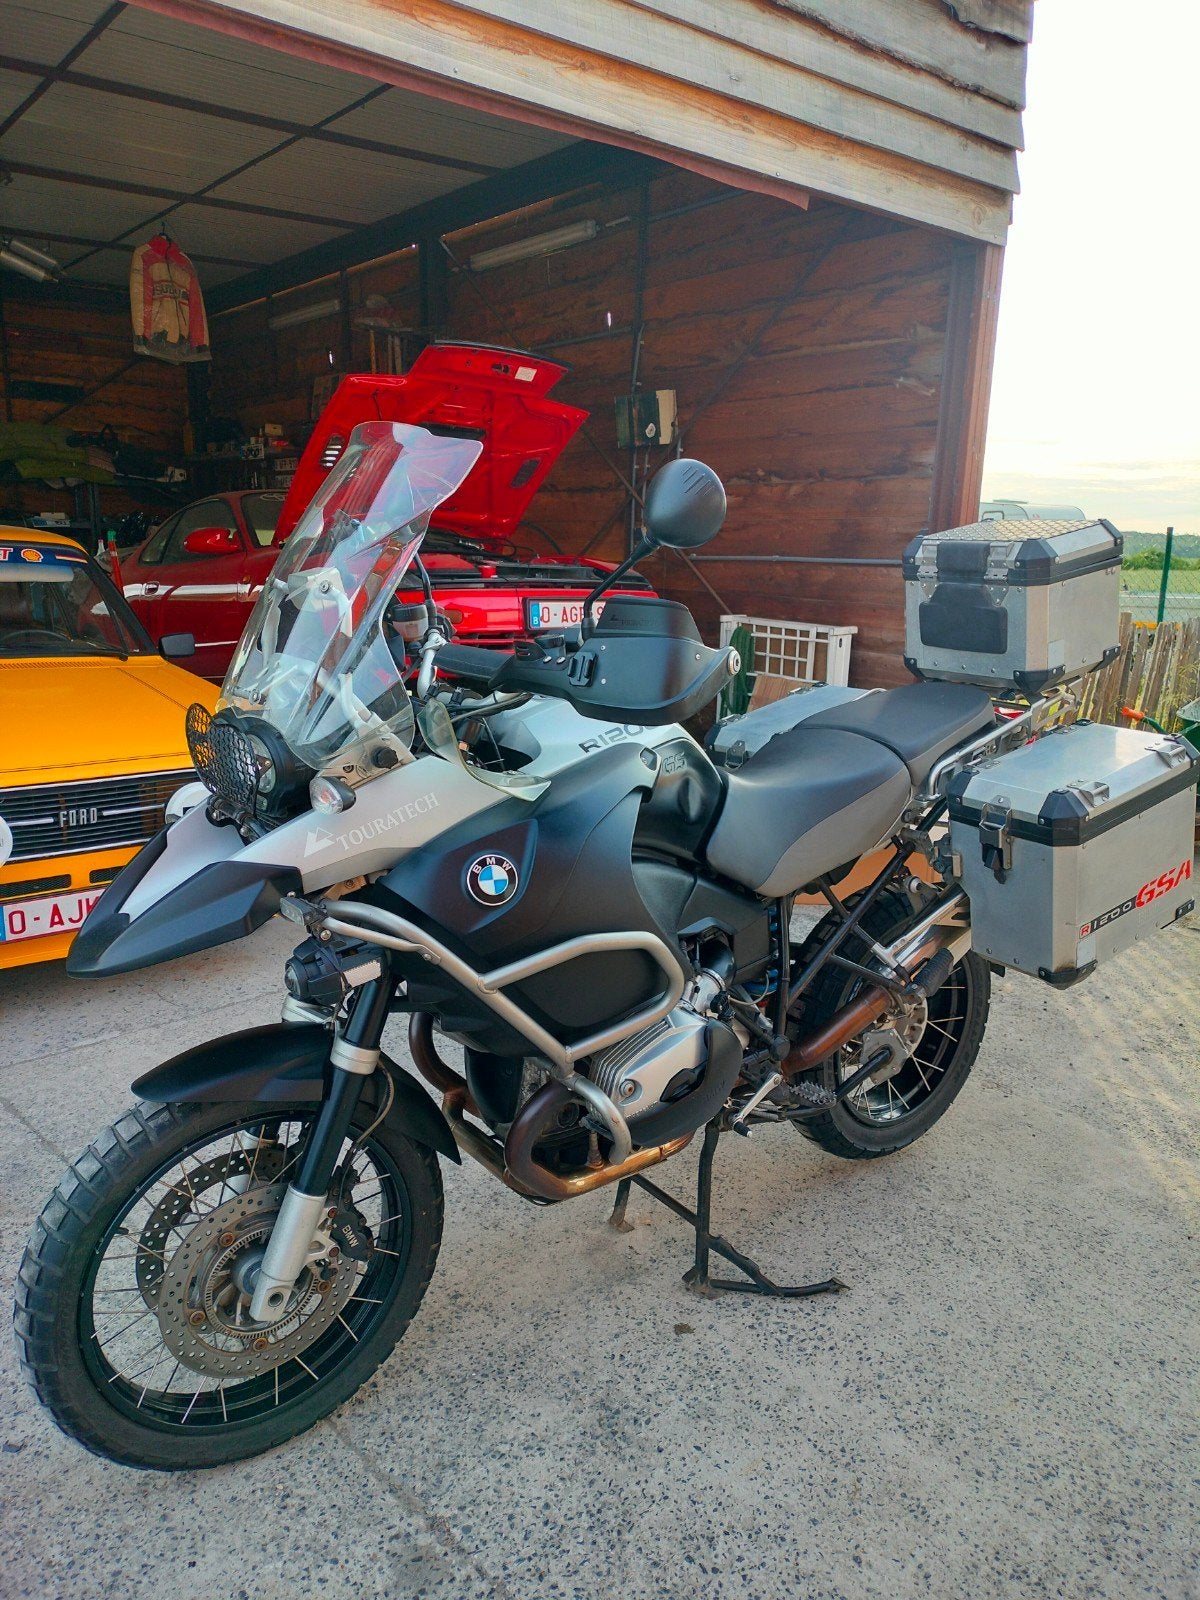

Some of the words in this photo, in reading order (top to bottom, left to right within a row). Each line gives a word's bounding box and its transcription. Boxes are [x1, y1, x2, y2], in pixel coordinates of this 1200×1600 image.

[533, 616, 539, 625] B
[579, 724, 655, 753] R120
[60, 807, 98, 828] FORD
[336, 792, 441, 850] TOURATECH
[472, 857, 512, 874] BMW
[1136, 859, 1191, 908] GSA
[342, 1224, 359, 1248] BMW
